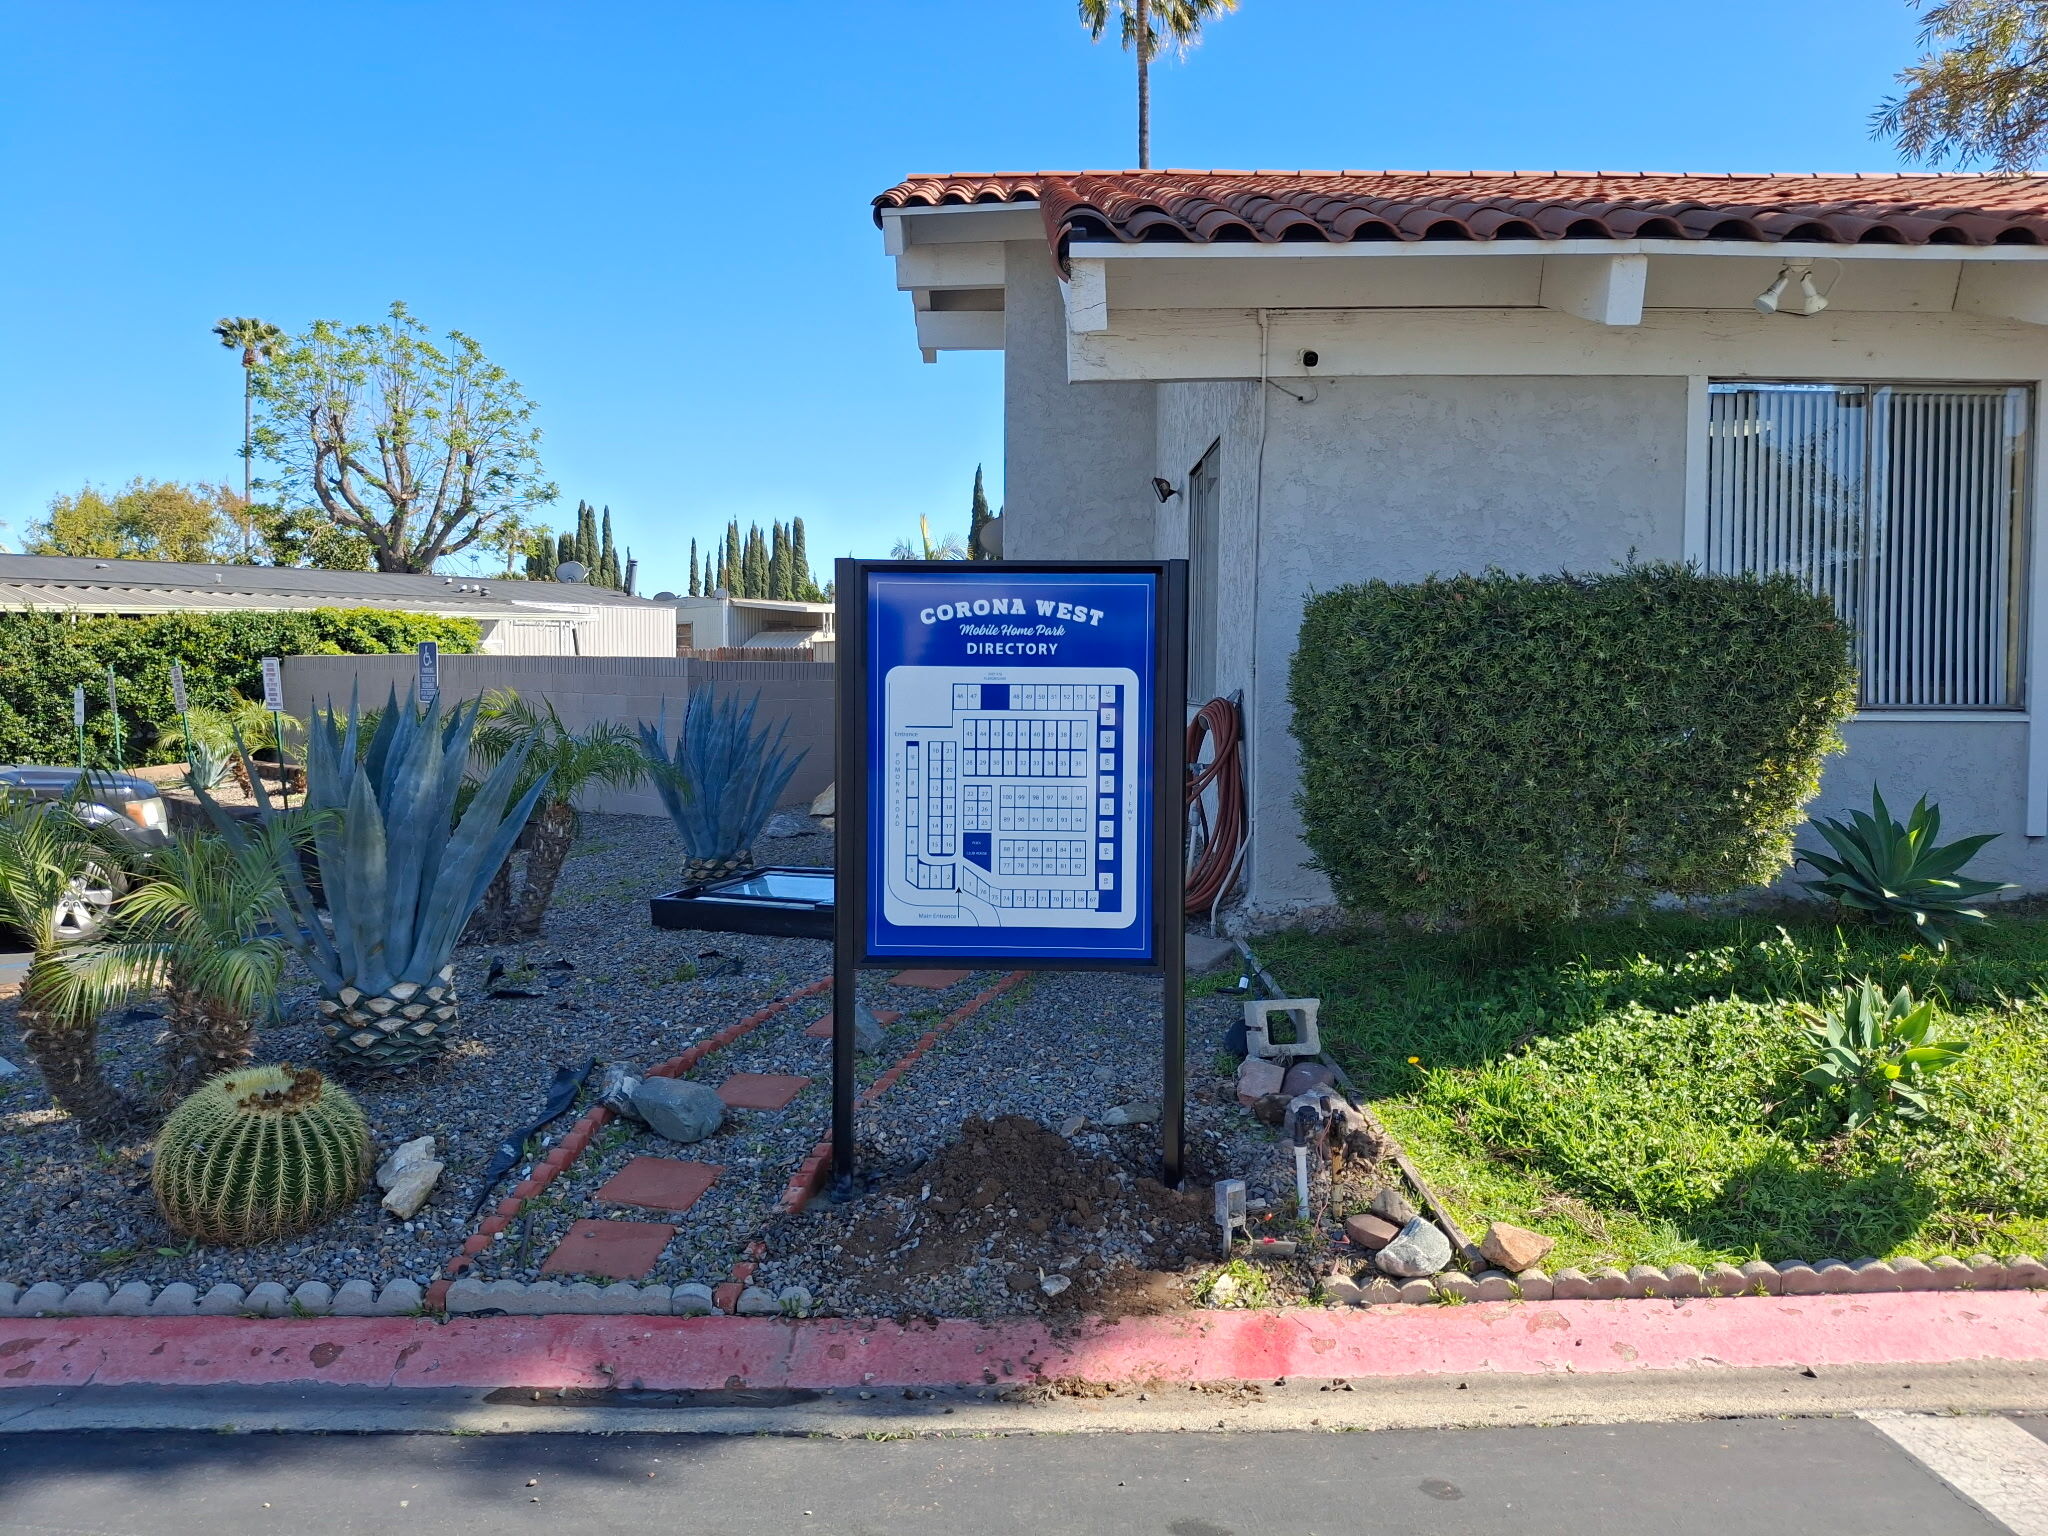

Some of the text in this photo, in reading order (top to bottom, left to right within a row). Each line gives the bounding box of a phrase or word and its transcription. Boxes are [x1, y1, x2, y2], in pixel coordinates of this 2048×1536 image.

[920, 598, 1104, 627] CORONA WEST
[959, 624, 1066, 637] Mobile Home Park
[966, 642, 1058, 655] DIRECTORY
